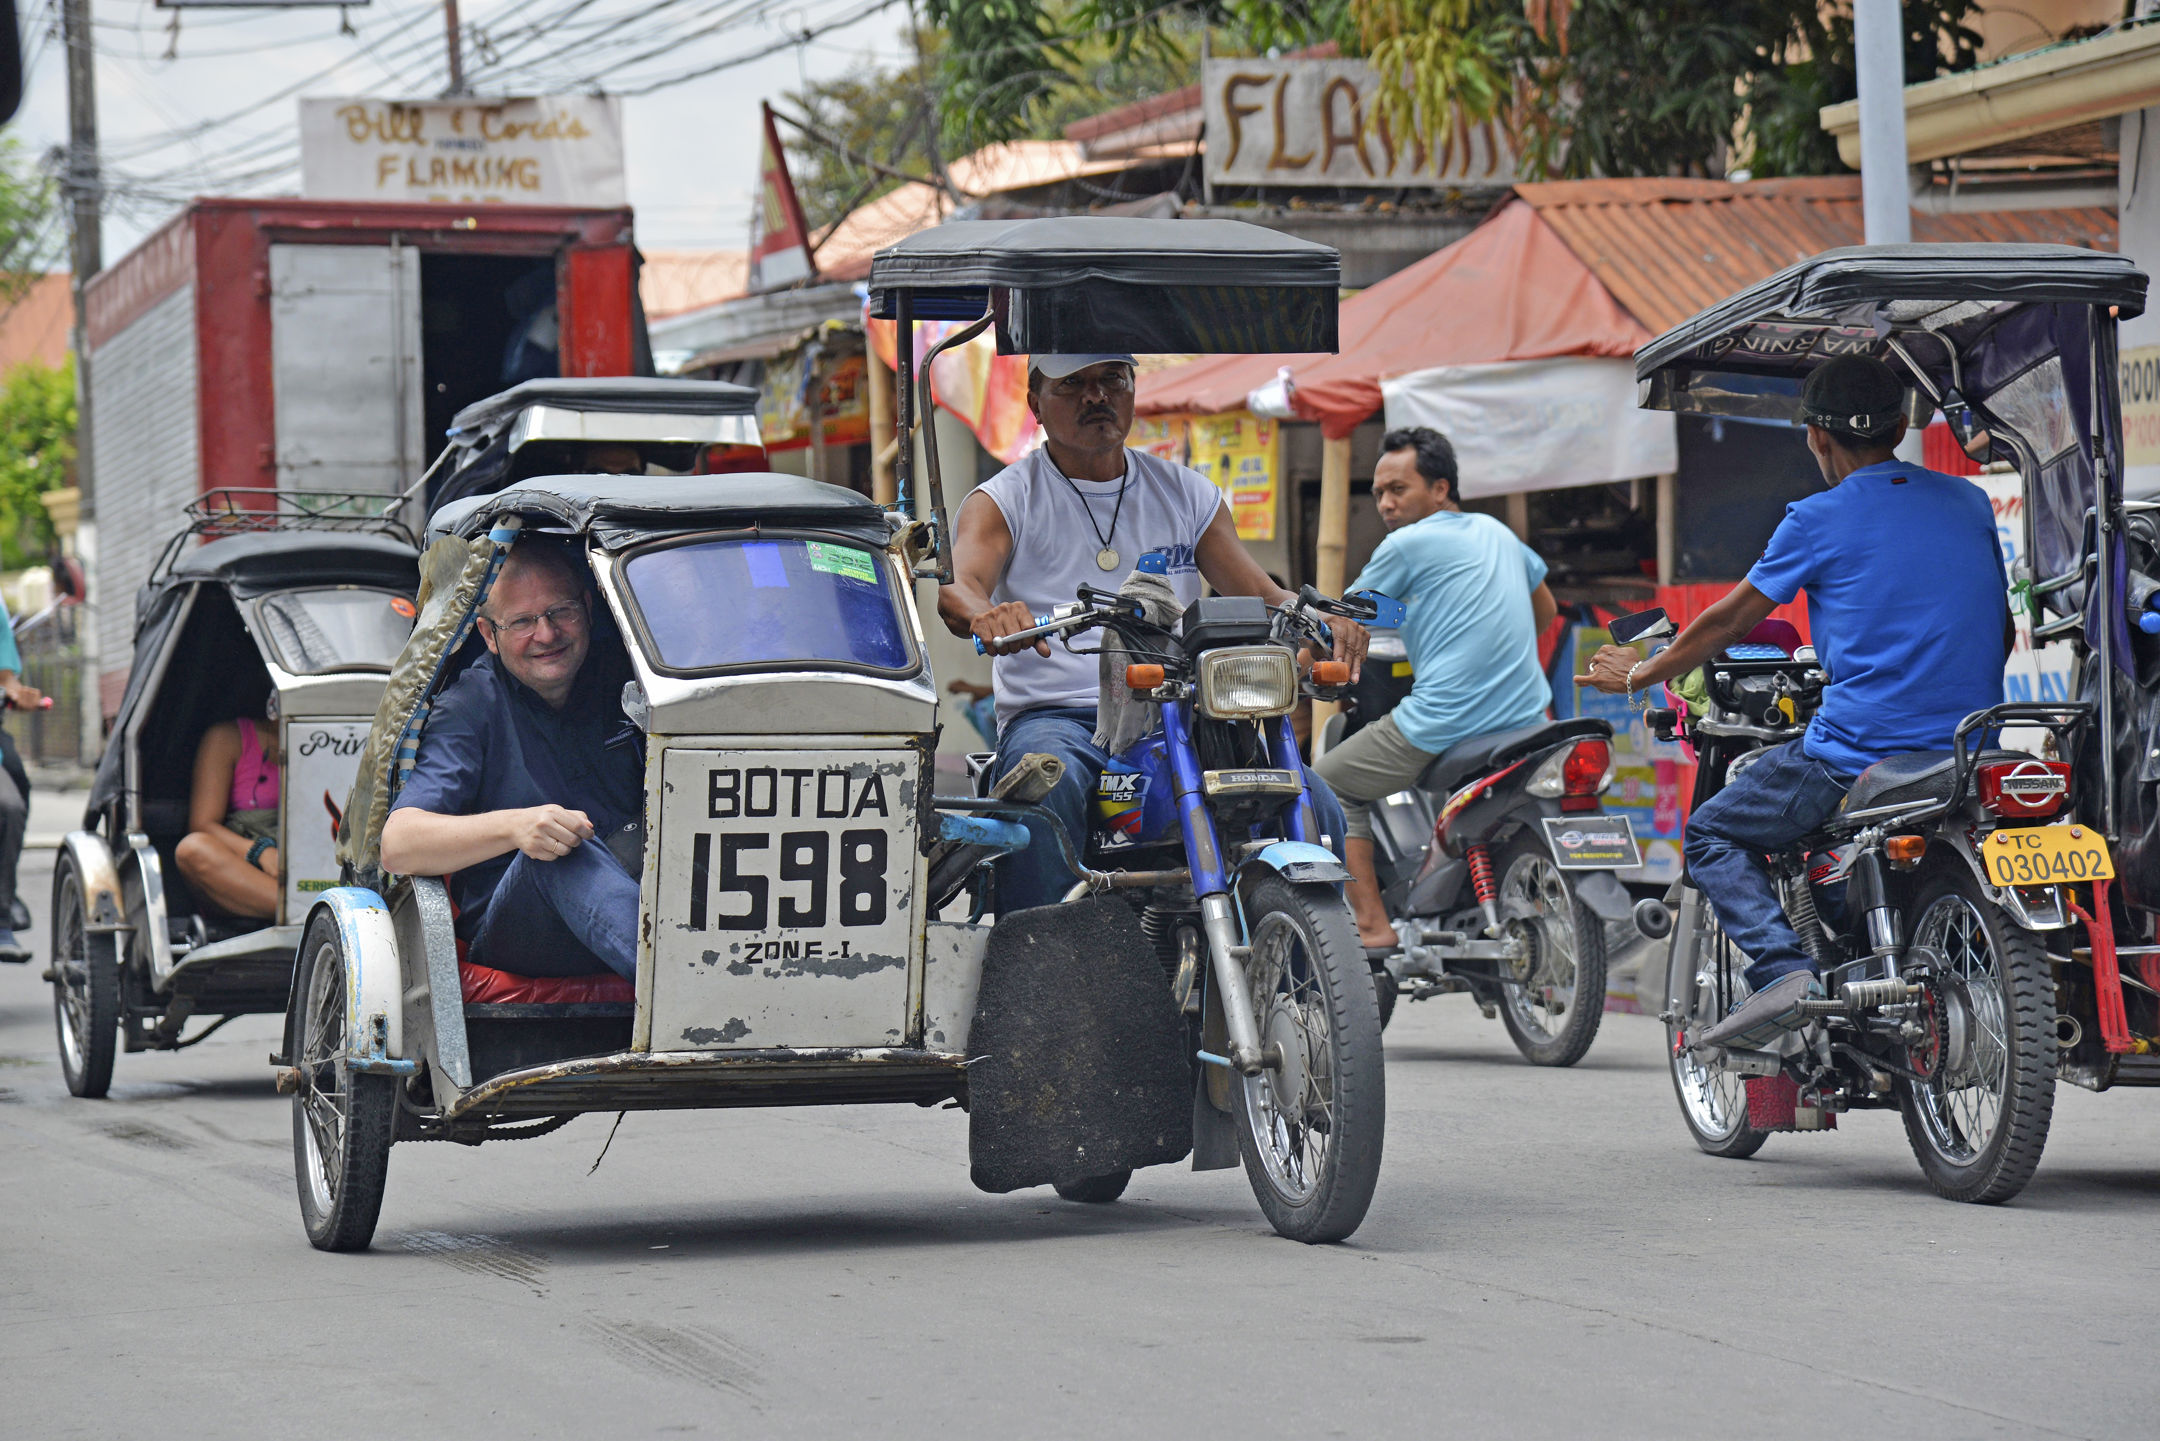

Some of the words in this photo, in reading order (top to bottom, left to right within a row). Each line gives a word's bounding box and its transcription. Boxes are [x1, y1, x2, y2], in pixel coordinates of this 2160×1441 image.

[336, 105, 425, 146] Bill
[376, 155, 541, 190] FLAMING
[1101, 773, 1142, 791] TMX
[1231, 775, 1281, 783] HONDA
[2008, 779, 2060, 789] NISSAN
[1111, 791, 1133, 802] 155
[2010, 834, 2042, 849] TC
[1996, 849, 2106, 883] 030402
[689, 829, 888, 932] 1598
